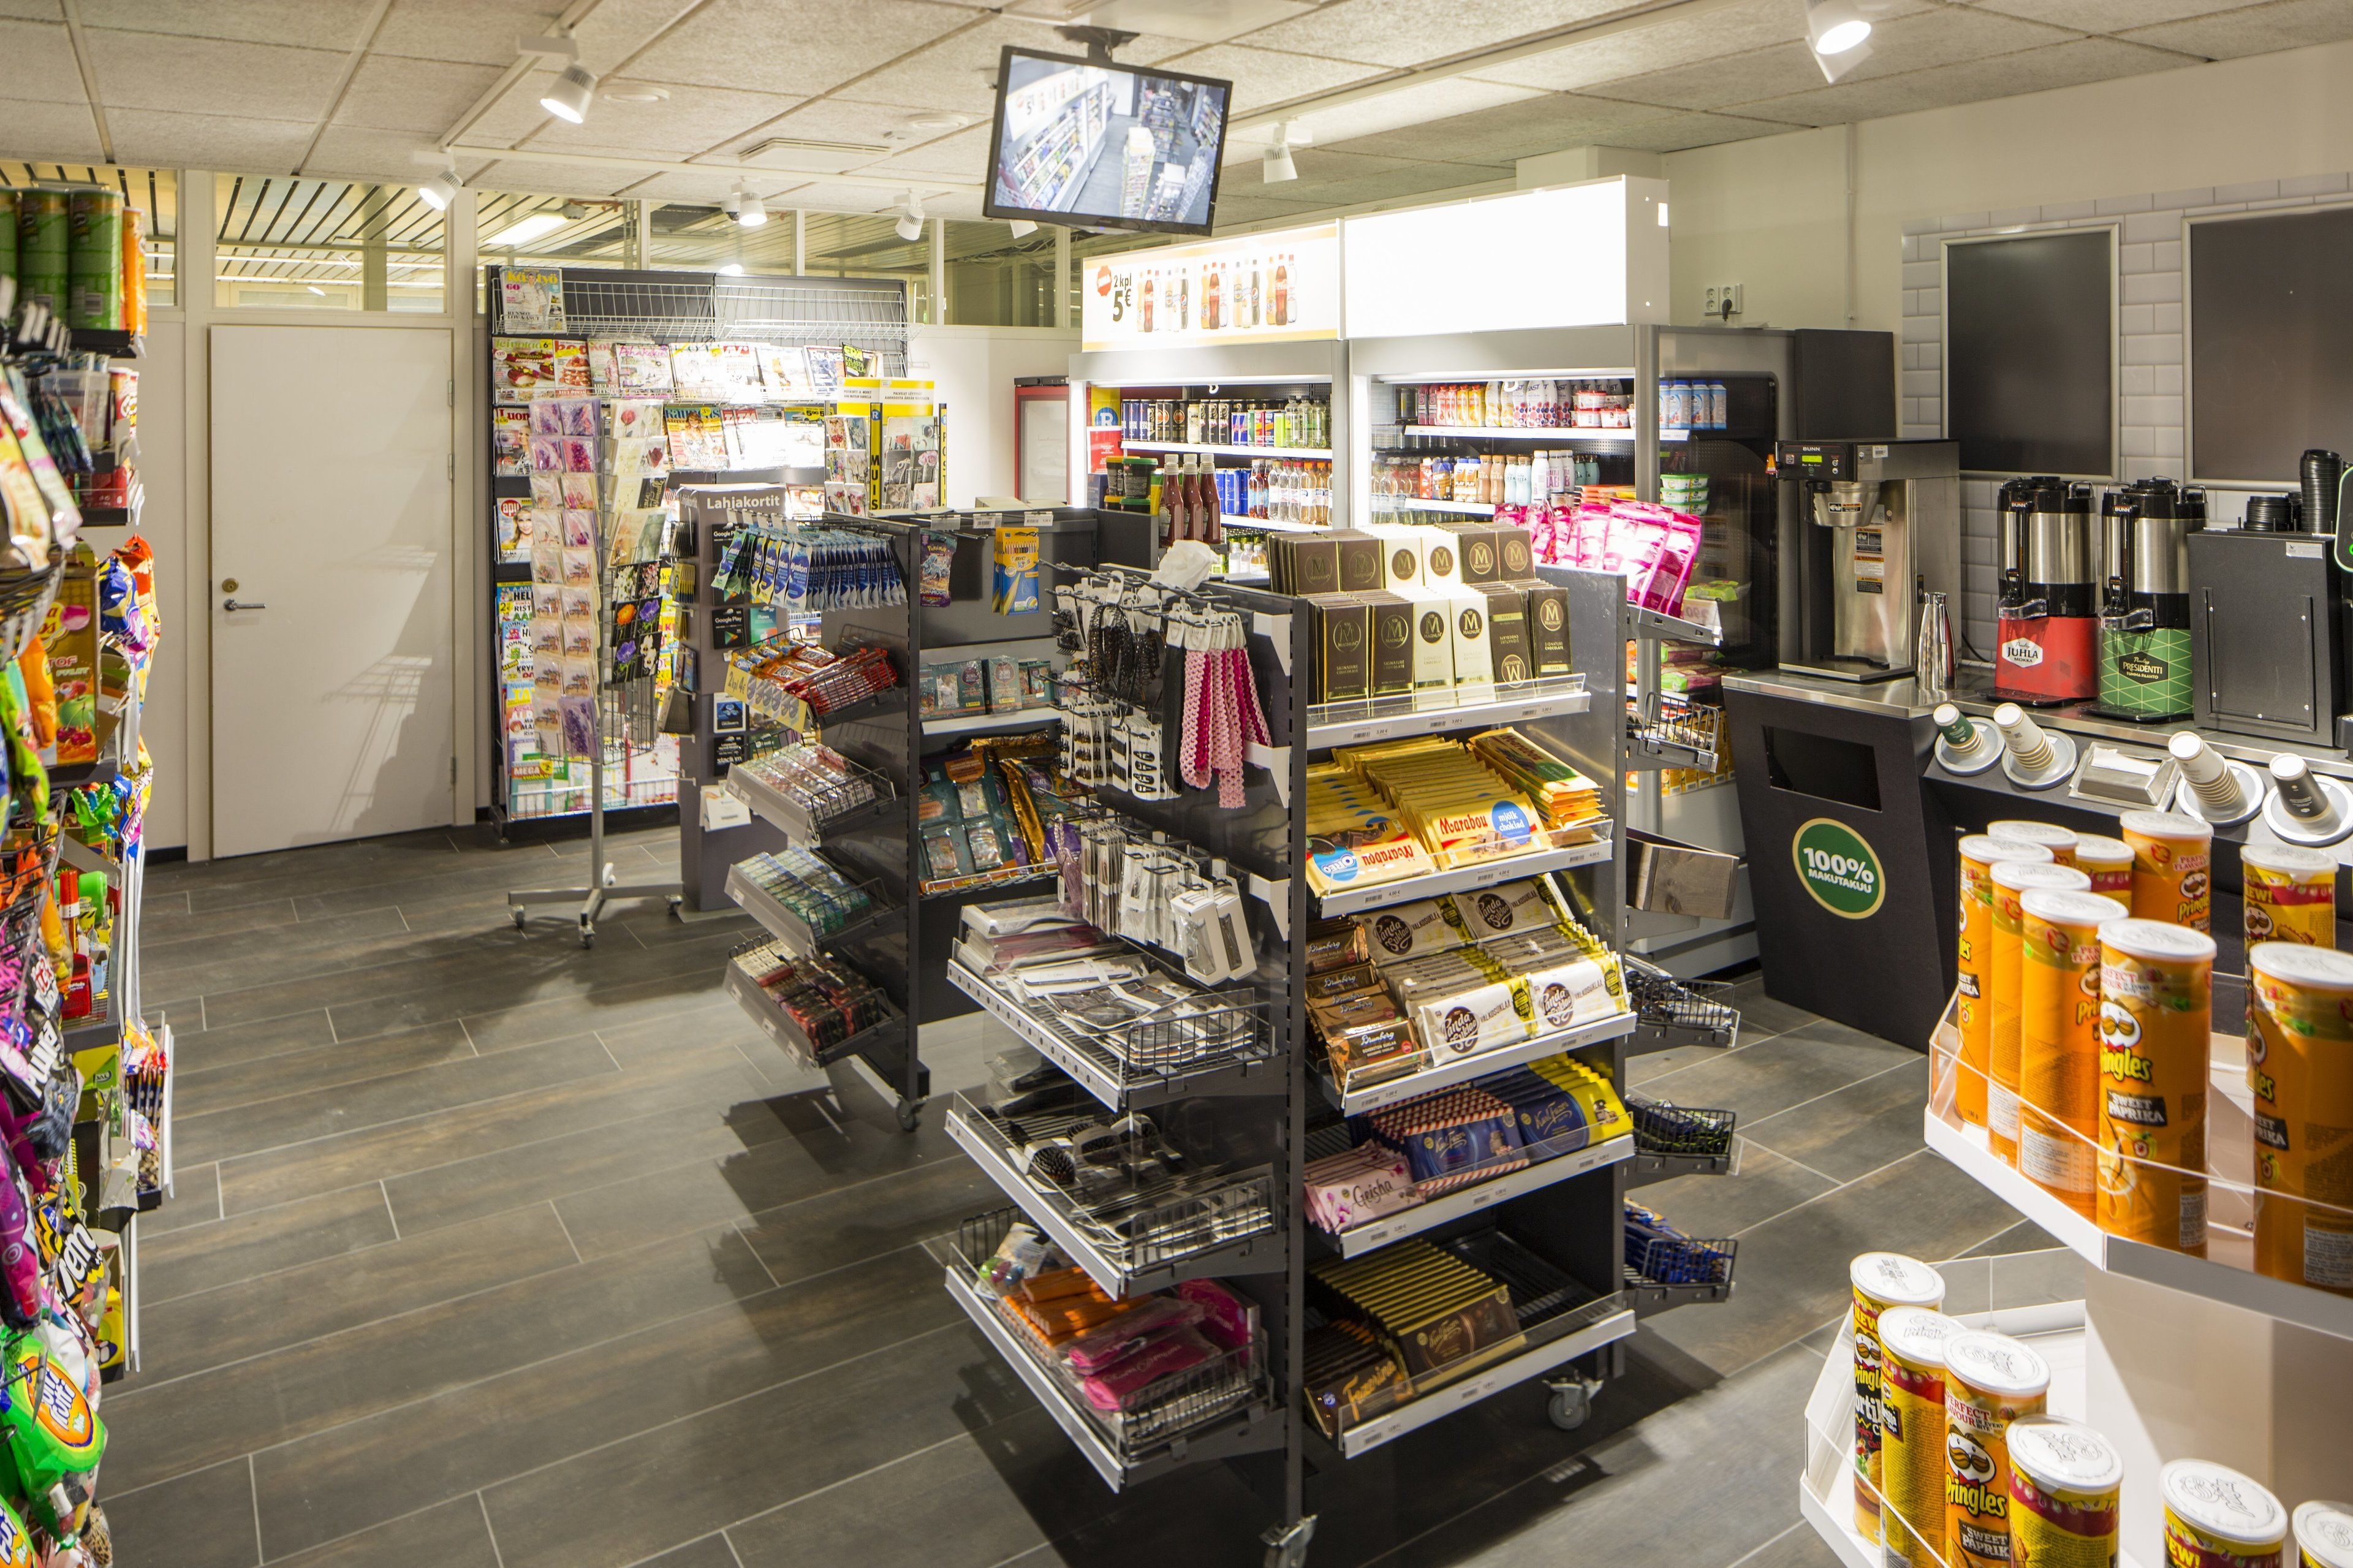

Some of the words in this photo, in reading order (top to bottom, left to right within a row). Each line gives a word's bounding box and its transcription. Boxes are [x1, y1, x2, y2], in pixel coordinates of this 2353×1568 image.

[502, 504, 520, 515] apu
[707, 495, 780, 510] Lahjakortit
[1434, 551, 1449, 566] M
[1474, 547, 1488, 564] M
[1509, 547, 1524, 561] M
[1464, 612, 1479, 629] M
[1545, 604, 1559, 621] M
[1425, 616, 1439, 632] M
[1543, 619, 1562, 627] MAGNUM
[1337, 640, 1358, 648] MAGNUM
[2007, 645, 2039, 660] JUHLA
[2123, 662, 2163, 675] PRESIDENTTI
[1502, 733, 1544, 760] Marabou
[1439, 813, 1488, 835] Marabou
[1498, 811, 1518, 824] mjölk
[1499, 819, 1525, 832] choklad
[1362, 844, 1414, 866] Marabou
[1321, 855, 1355, 874] OREO
[1803, 847, 1875, 885] 100%
[1808, 868, 1872, 894] MAKUTAKUU
[1477, 898, 1501, 916] Panda
[1373, 920, 1401, 943] Panda
[1309, 941, 1341, 952] Brunberg
[1324, 974, 1357, 987] Brunberg
[1574, 979, 1604, 999] VALKOSUKLAA
[1340, 1000, 1374, 1013] Brunberg
[1540, 990, 1566, 1012] Panda
[1480, 999, 1512, 1023] VALKOSUKLAA
[1442, 1012, 1471, 1040] Panda
[1361, 1031, 1395, 1046] Brunberg
[2108, 1105, 2165, 1124] PAPRIKA
[1352, 1176, 1394, 1208] Geisha
[1947, 1393, 1991, 1420] PERFECT
[1946, 1474, 2007, 1518] Pringles
[1961, 1533, 2010, 1560] PAPRIK
